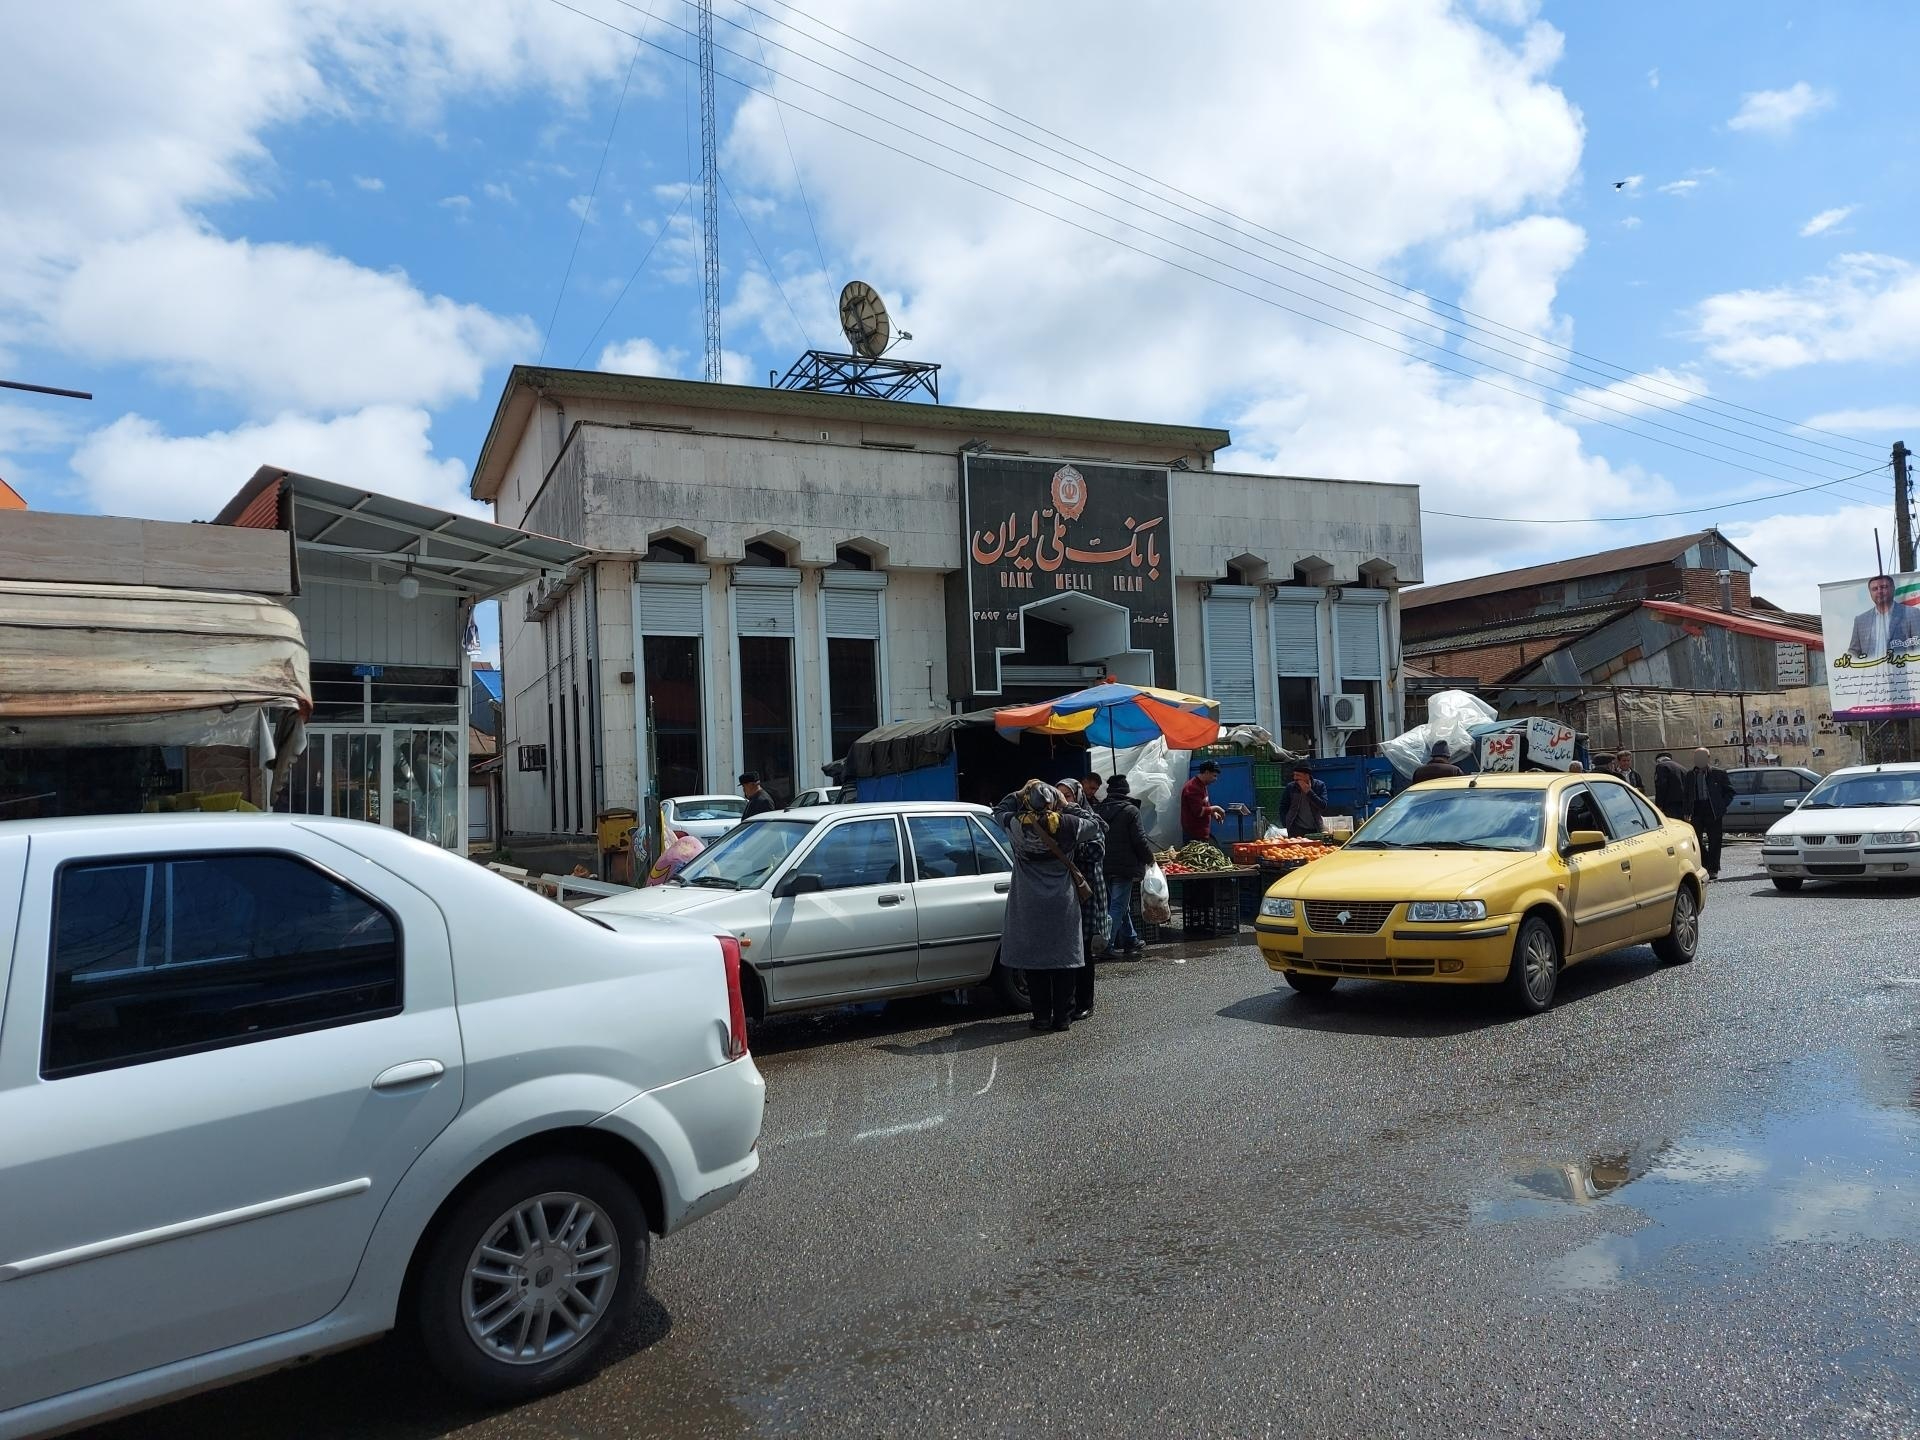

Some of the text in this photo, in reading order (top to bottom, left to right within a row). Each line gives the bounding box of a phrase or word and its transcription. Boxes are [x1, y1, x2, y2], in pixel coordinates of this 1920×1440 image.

[972, 510, 1038, 570] ایران
[1066, 516, 1164, 581] بانک
[1000, 571, 1143, 592] BANK MELLI IRAN
[1488, 736, 1514, 755] گردو
[1551, 728, 1573, 747] عسل
